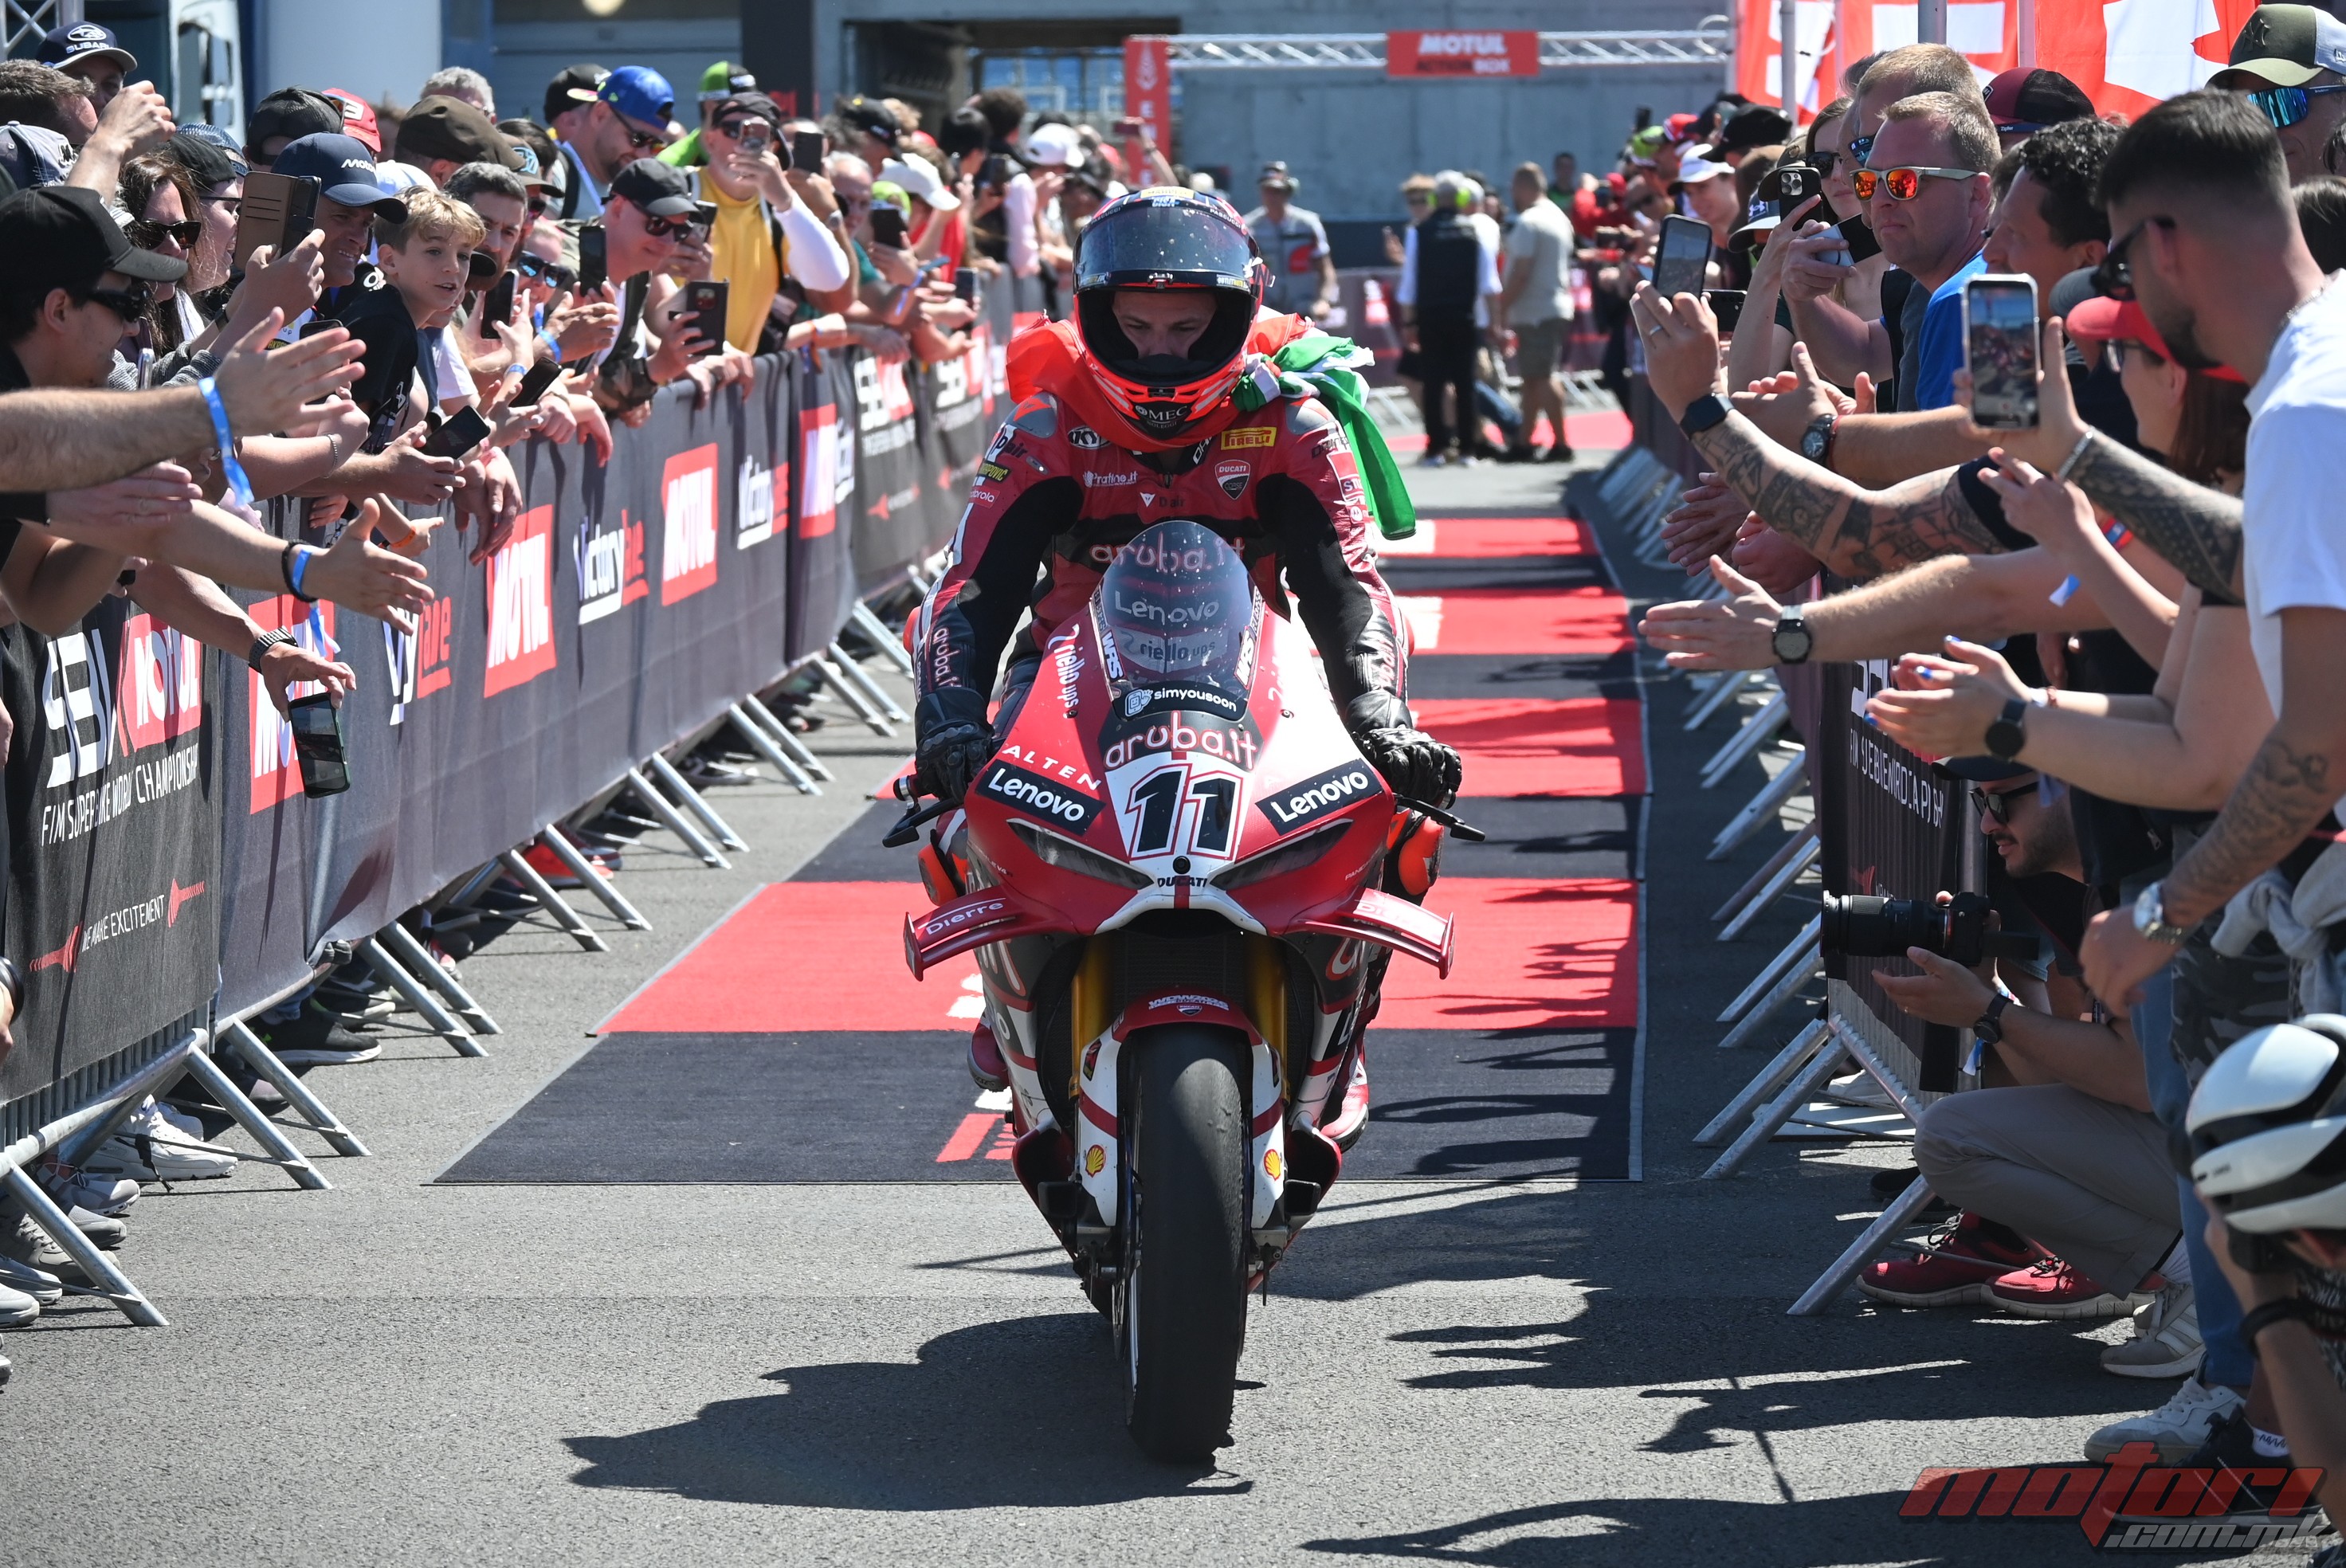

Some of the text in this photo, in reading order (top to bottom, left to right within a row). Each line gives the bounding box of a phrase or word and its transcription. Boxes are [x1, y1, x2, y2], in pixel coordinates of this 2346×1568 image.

[65, 41, 112, 54] SUBAR
[1418, 33, 1508, 55] MOTUL
[1148, 405, 1188, 421] MEC
[1224, 430, 1272, 447] PIRELLI
[1115, 590, 1220, 625] Lenovo
[1140, 640, 1189, 662] riello
[1054, 644, 1085, 708] riello ups
[1154, 688, 1237, 712] simyousoon
[1104, 711, 1257, 770] aruba.it
[1002, 745, 1101, 790] ALTEN
[988, 767, 1085, 821] Lenovo
[1130, 766, 1240, 857] 11
[1270, 772, 1369, 823] Lenovo
[41, 801, 65, 847] FIM
[1157, 877, 1208, 888] DUCATI
[111, 894, 165, 937] EXCITEMENT
[926, 902, 1004, 935] Dierre
